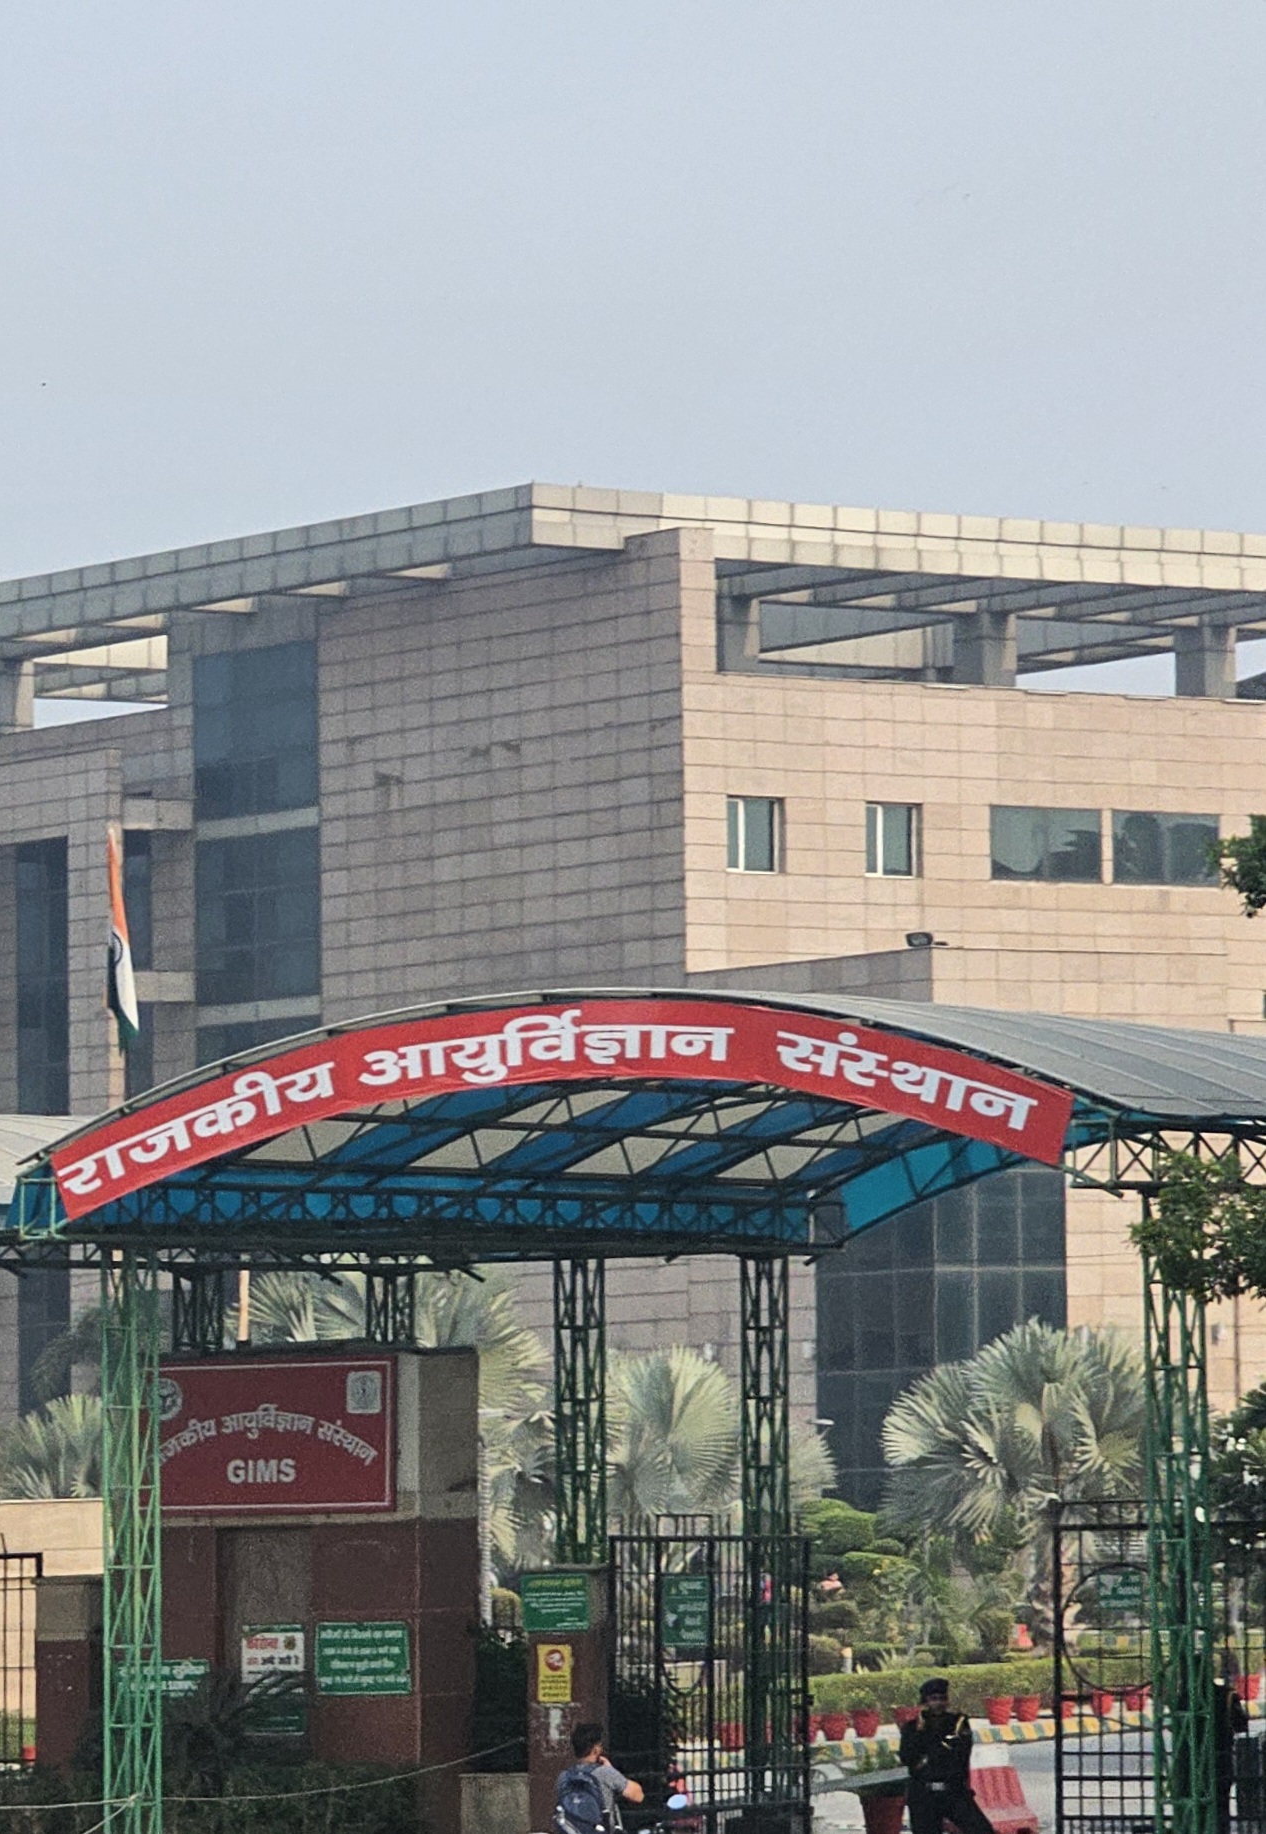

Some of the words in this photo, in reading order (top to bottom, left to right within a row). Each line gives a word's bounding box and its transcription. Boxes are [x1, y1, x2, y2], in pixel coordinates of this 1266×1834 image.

[57, 1062, 335, 1195] राजकीय
[358, 1009, 735, 1086] आयुर्विज्ञान
[776, 1031, 1038, 1131] संस्थान
[221, 1403, 316, 1440] आयुर्विज्ञान
[318, 1419, 379, 1466] संस्थान
[227, 1458, 296, 1484] GIMS
